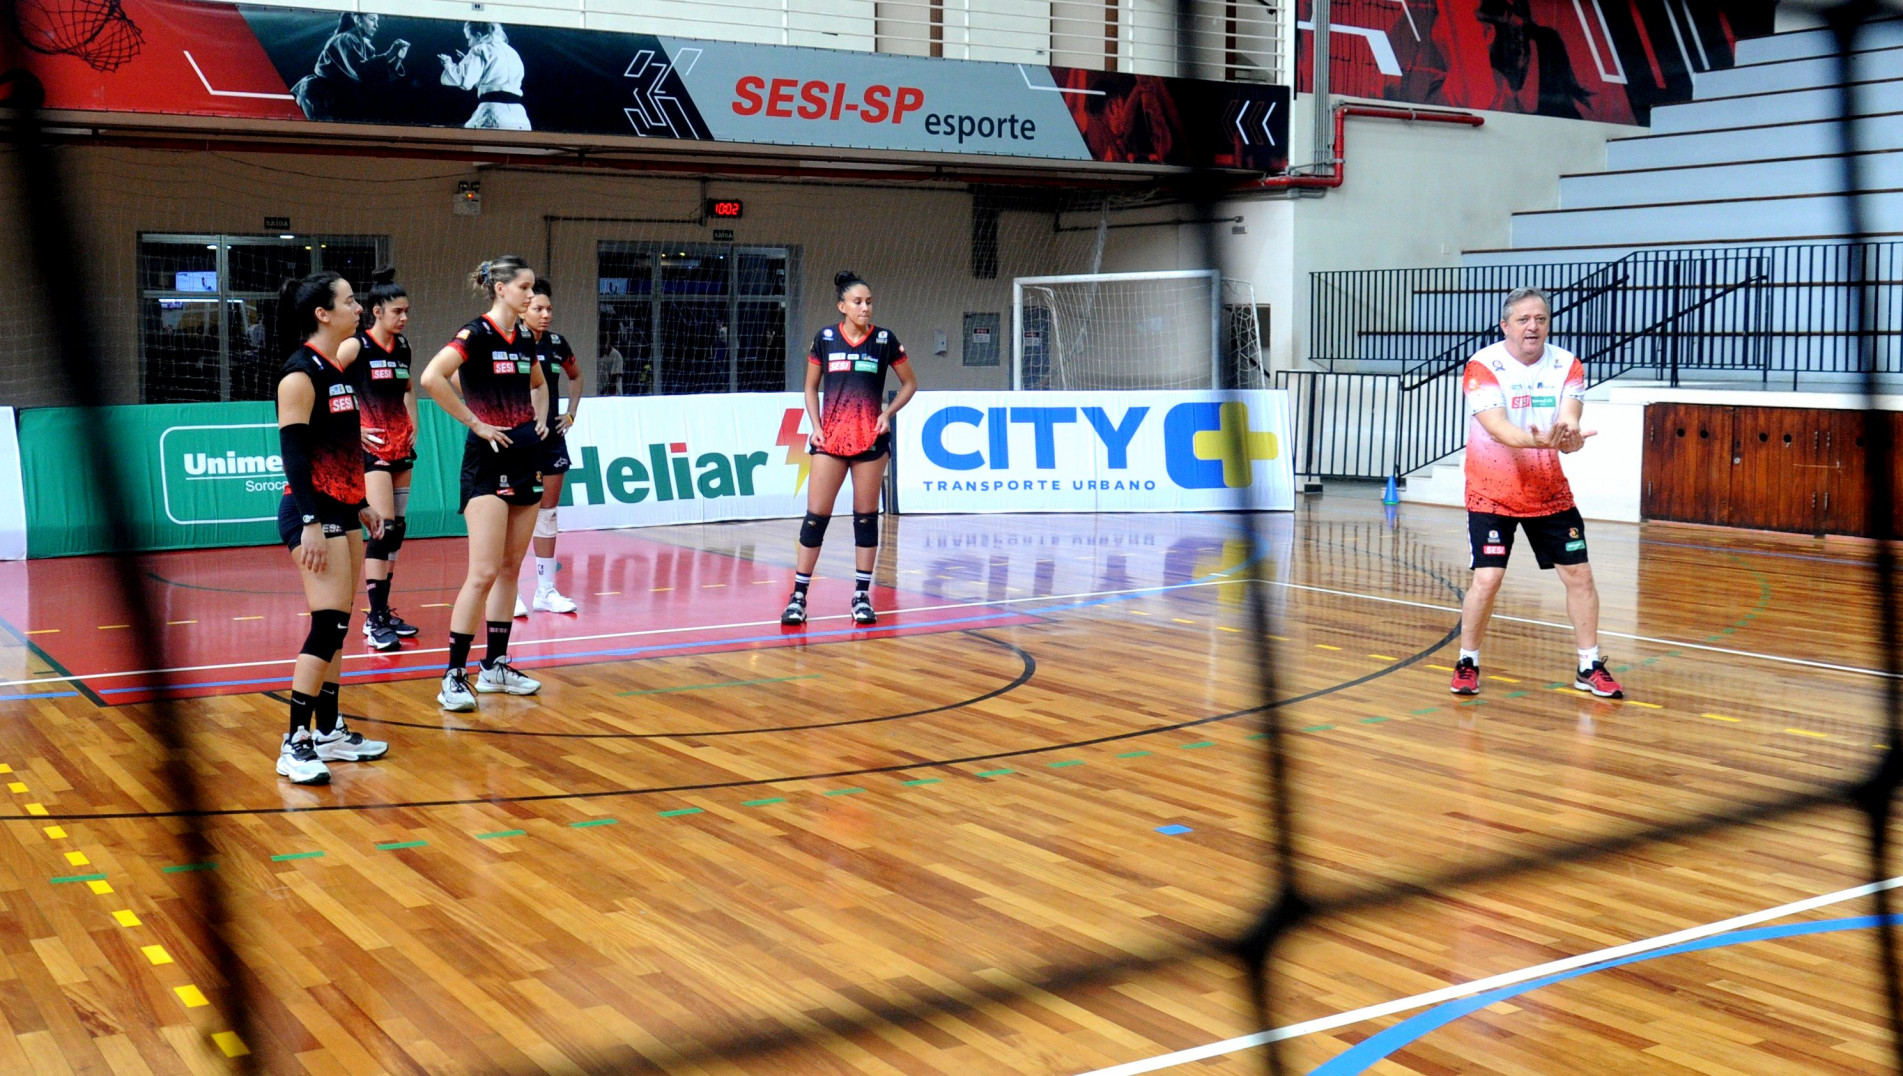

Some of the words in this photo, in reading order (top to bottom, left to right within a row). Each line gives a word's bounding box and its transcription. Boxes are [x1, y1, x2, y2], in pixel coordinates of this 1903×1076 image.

[732, 76, 925, 124] SESI-SP
[925, 113, 1036, 144] esporte
[374, 369, 392, 379] SESI
[496, 362, 515, 373] SESI
[332, 397, 354, 412] SESI
[921, 405, 1151, 471] CITY
[183, 451, 284, 475] Unime
[557, 442, 769, 507] Heliar
[245, 480, 289, 492] Soroca
[923, 479, 1062, 492] TRANSPORTE
[1072, 479, 1156, 491] URBANO
